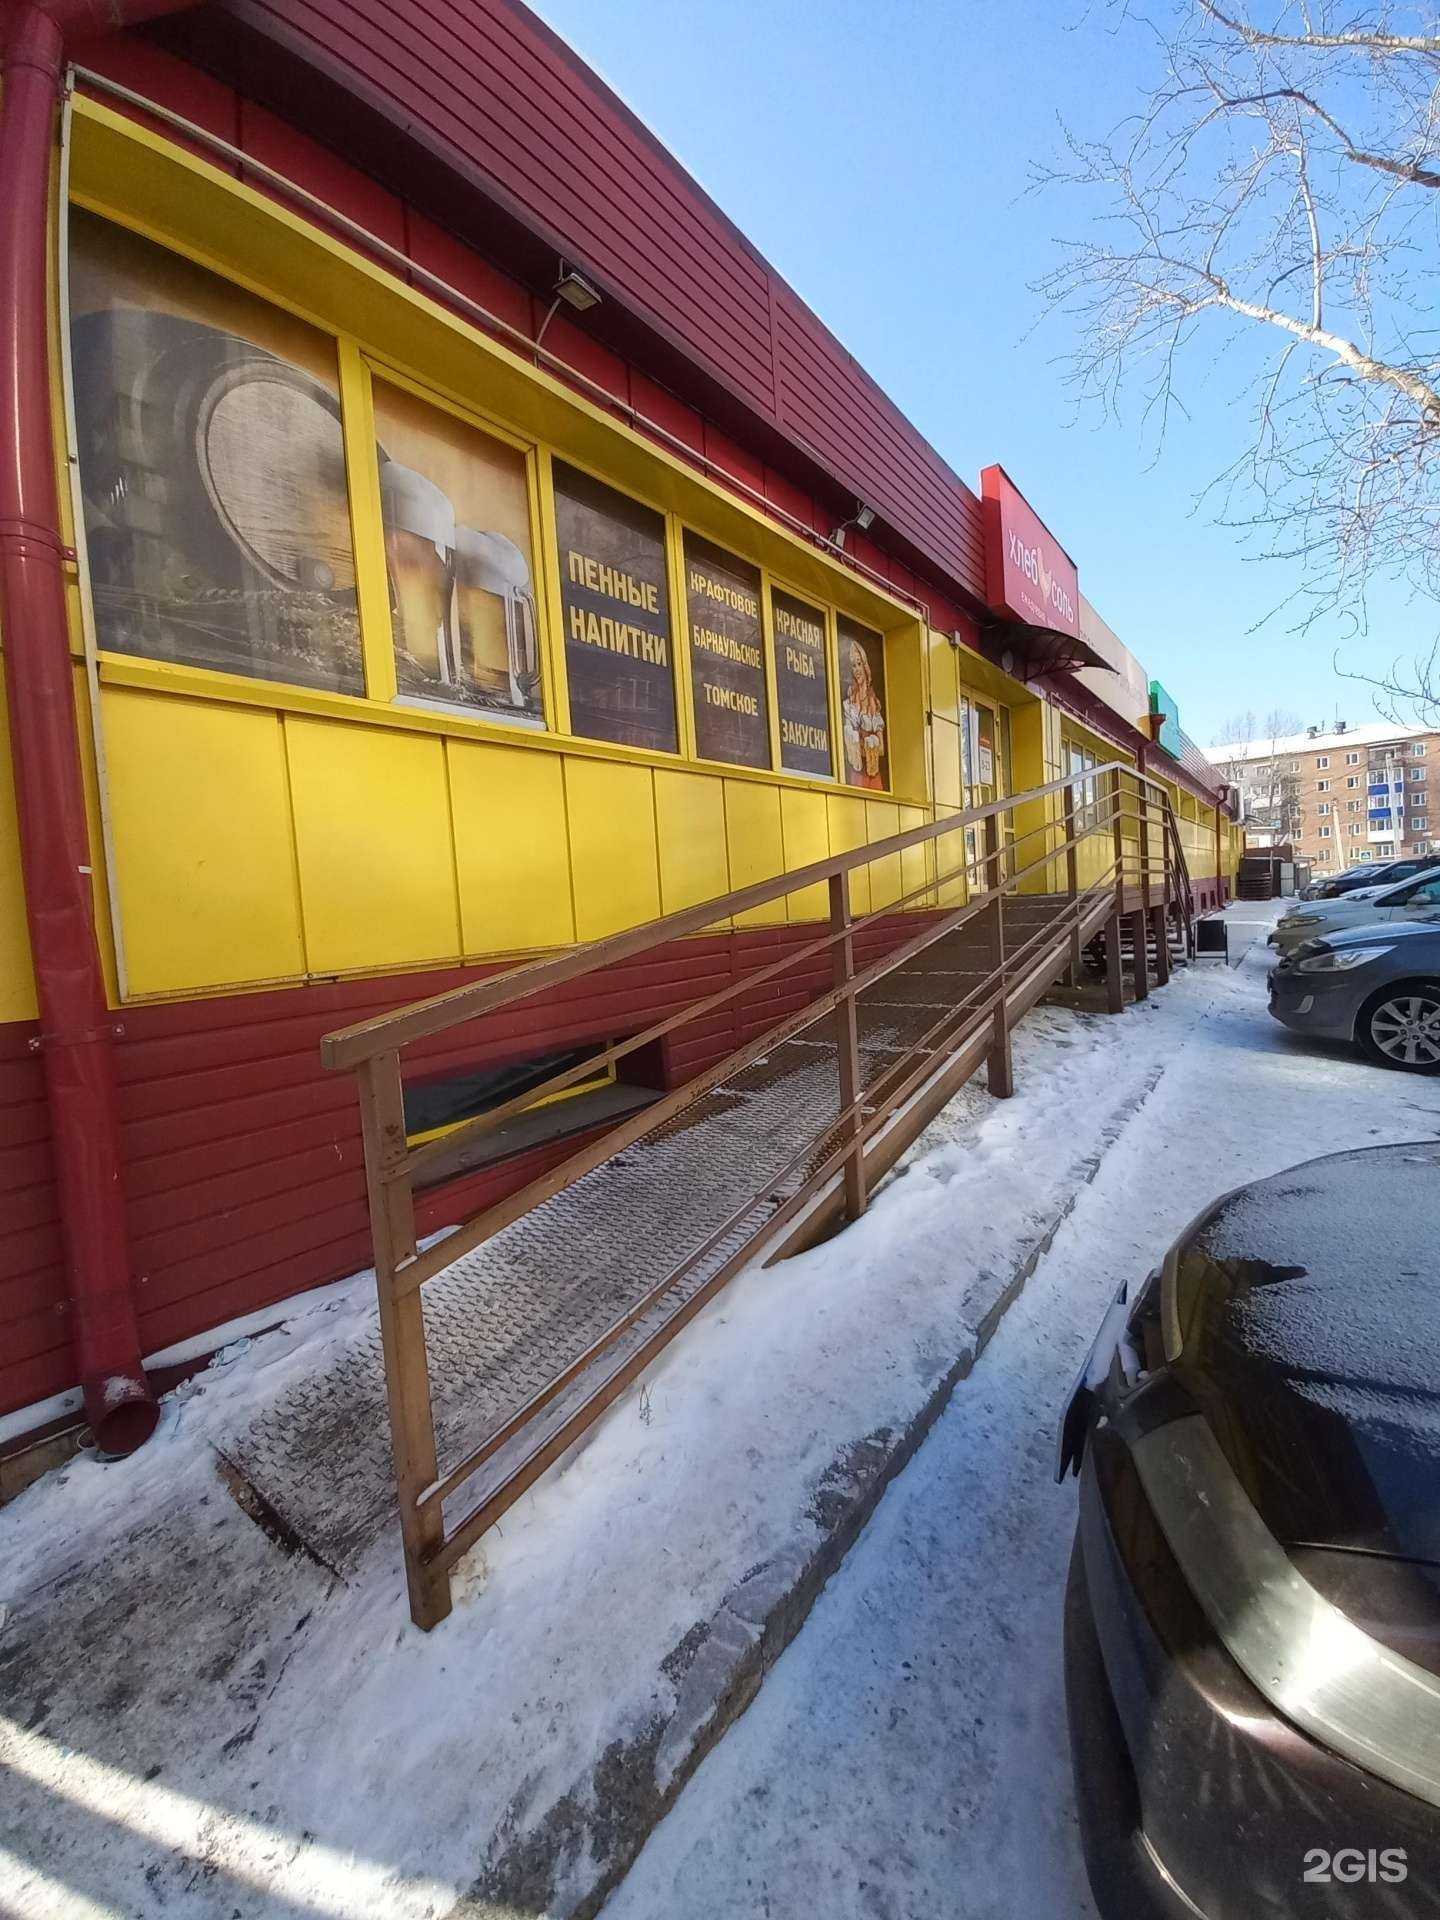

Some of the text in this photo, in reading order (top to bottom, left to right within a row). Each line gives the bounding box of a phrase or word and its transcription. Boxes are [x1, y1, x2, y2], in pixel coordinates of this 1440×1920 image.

[568, 550, 660, 615] ПЕННЫЕ
[690, 571, 758, 618] КРАФТОВОЕ
[569, 605, 667, 667] НАПИТКИ
[693, 625, 762, 669] БАРНАУЛЬСКОЕ
[776, 608, 820, 649] КРАСНАЯ
[786, 647, 815, 679] РЫБА
[703, 683, 759, 716] ТОМСКОЕ
[782, 718, 827, 752] ЗАКУСКИ
